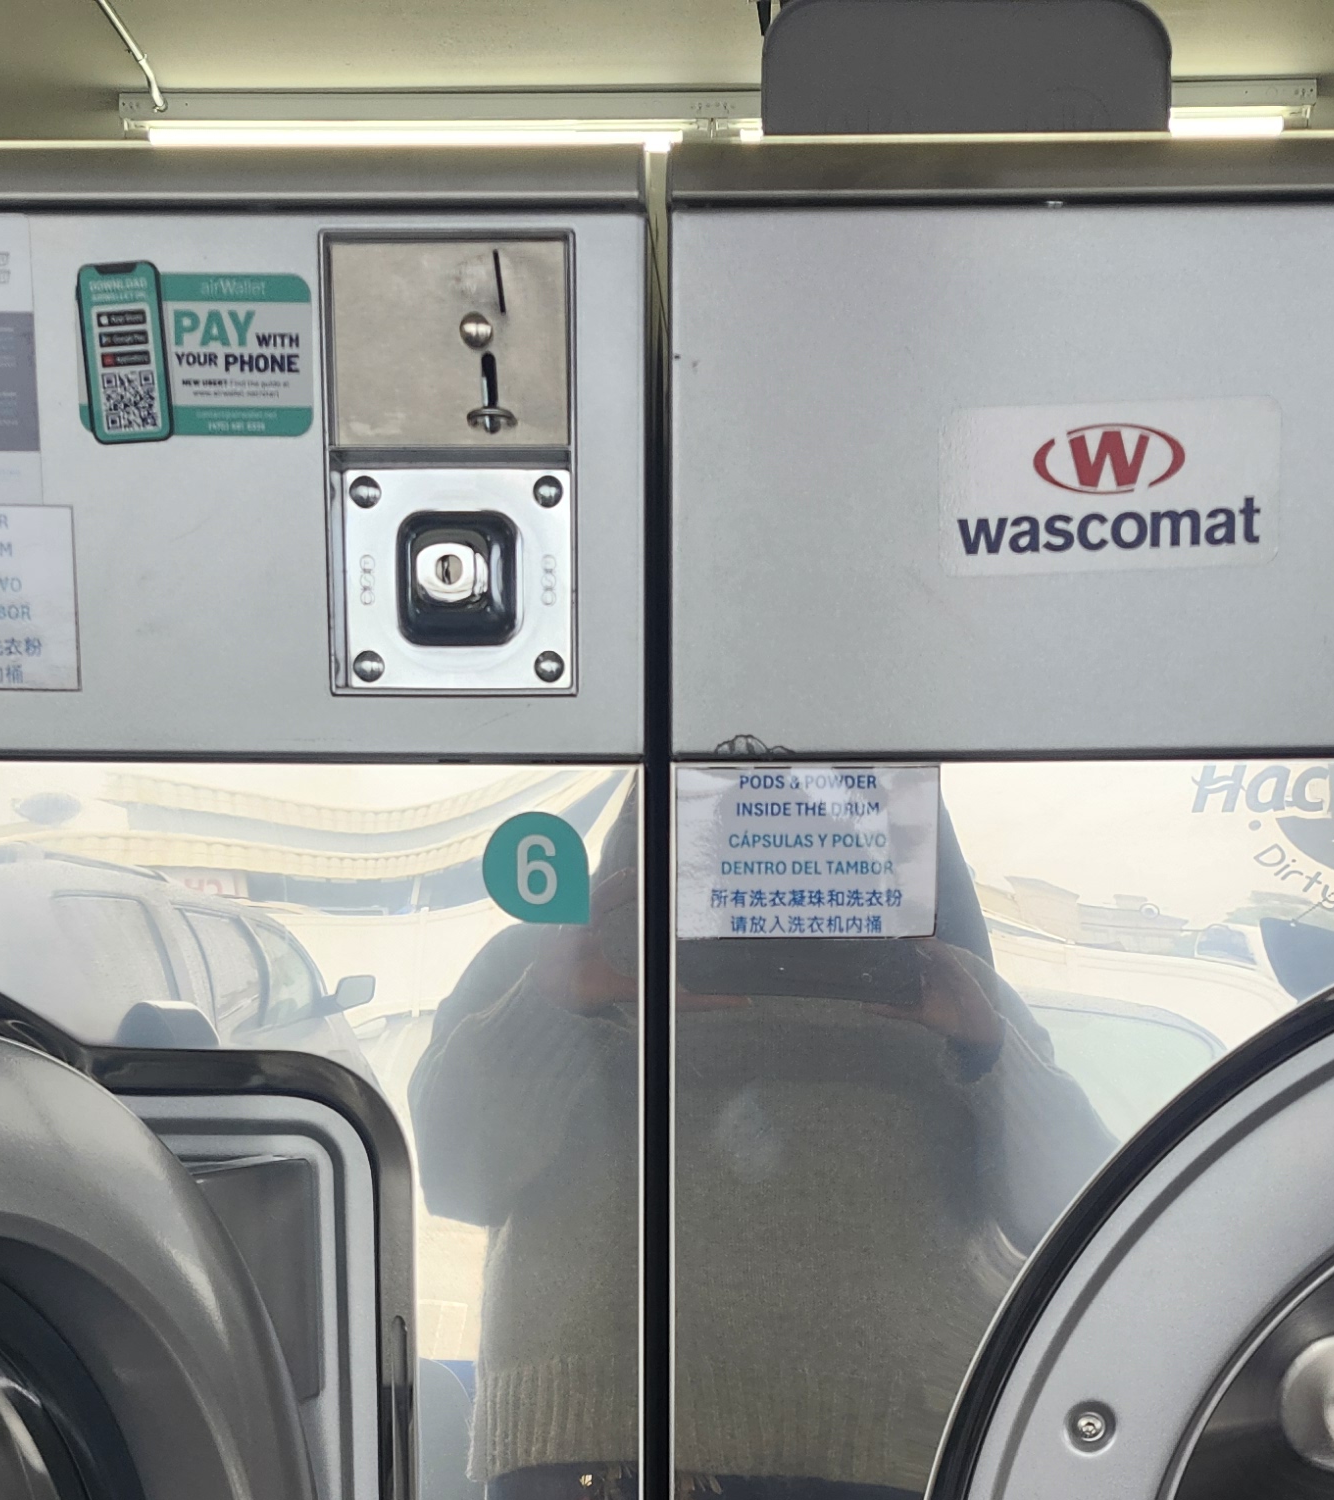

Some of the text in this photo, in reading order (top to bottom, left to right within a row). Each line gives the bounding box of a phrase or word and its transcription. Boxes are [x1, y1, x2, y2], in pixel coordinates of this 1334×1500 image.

[173, 309, 256, 347] PAY
[256, 333, 300, 348] WITH
[175, 352, 300, 373] YOUR PHONE
[957, 495, 1261, 556] wascomat
[739, 775, 877, 790] PODS & POWDER
[736, 801, 880, 817] INSIDE THE DRUM
[729, 830, 887, 849] CÁPSULAS Y POLVO
[517, 834, 557, 905] 6
[721, 860, 894, 875] DENTRO DEL TAMBOR
